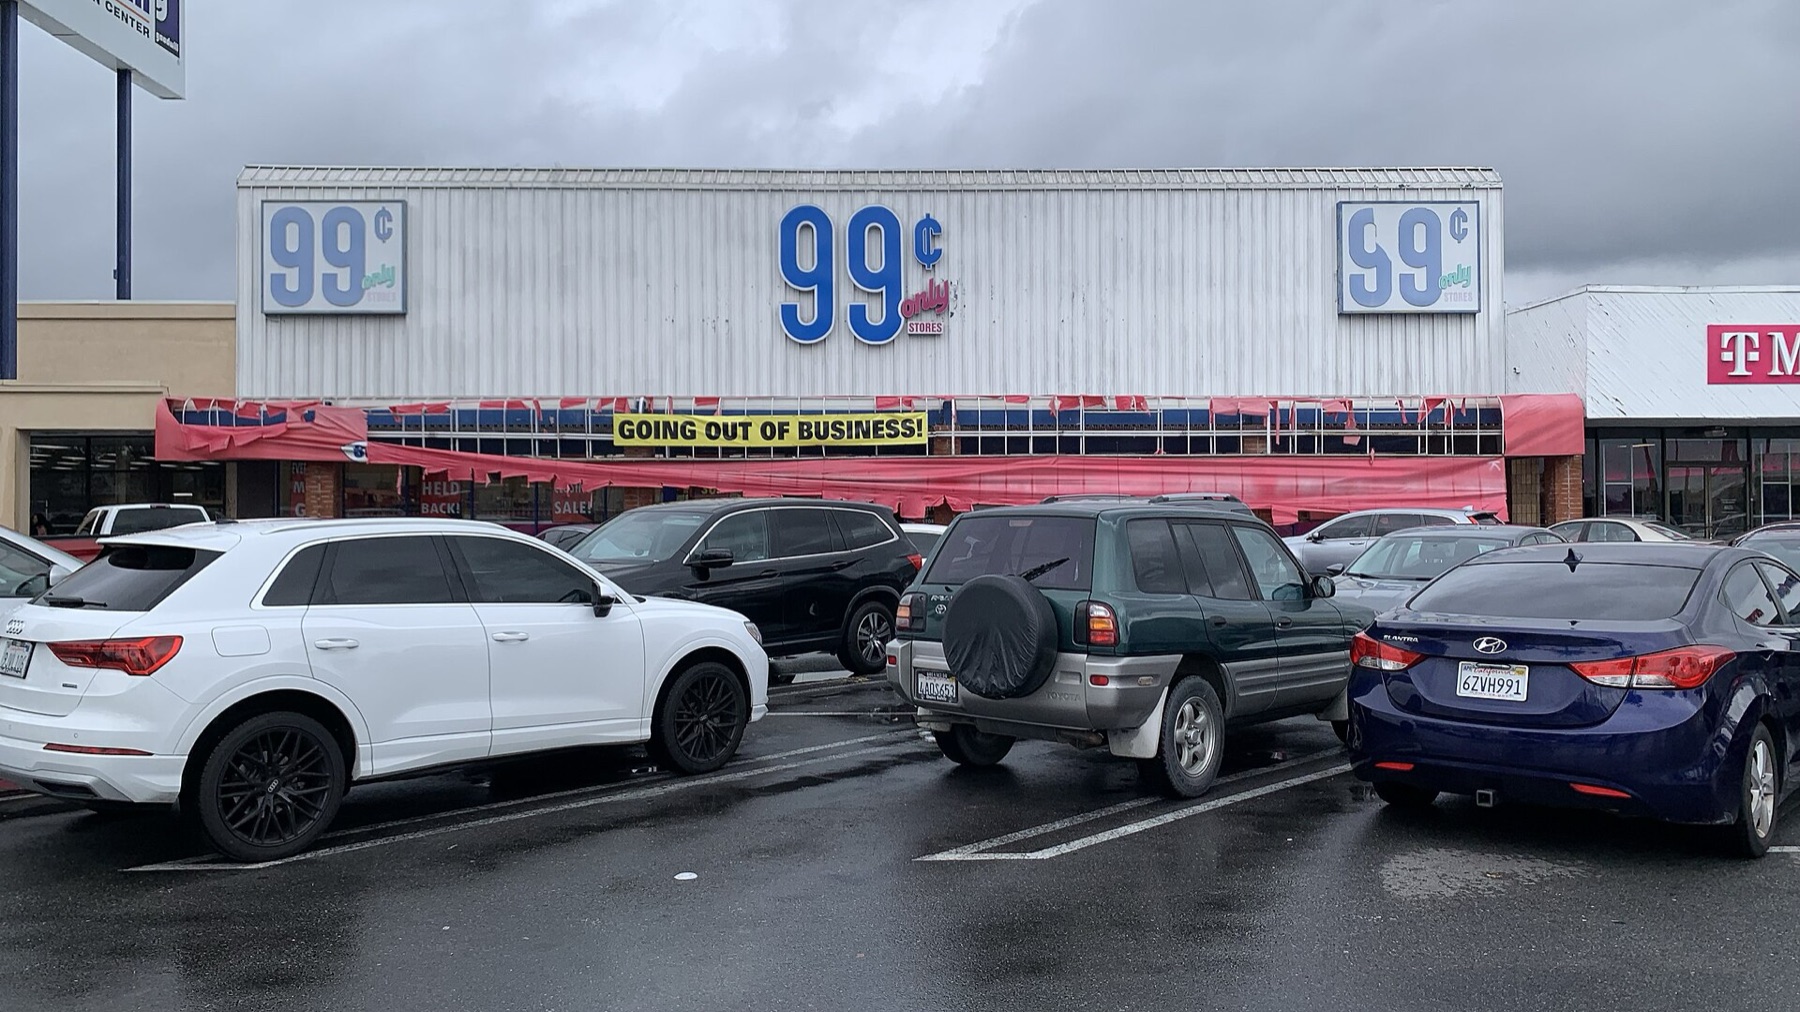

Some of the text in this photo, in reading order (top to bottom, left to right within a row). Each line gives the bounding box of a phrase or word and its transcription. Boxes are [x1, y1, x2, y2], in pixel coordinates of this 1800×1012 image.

[105, 0, 150, 39] CENTER
[361, 263, 396, 290] only
[1439, 263, 1471, 290] only
[901, 277, 950, 319] only
[1444, 292, 1473, 302] STORES
[908, 322, 943, 333] STORES
[618, 418, 923, 441] GOING OUT OF BUSINESS!
[422, 481, 459, 496] HELD
[421, 502, 460, 514] BACK!
[554, 501, 592, 514] SALE!
[1462, 675, 1522, 696] 6ZVH991
